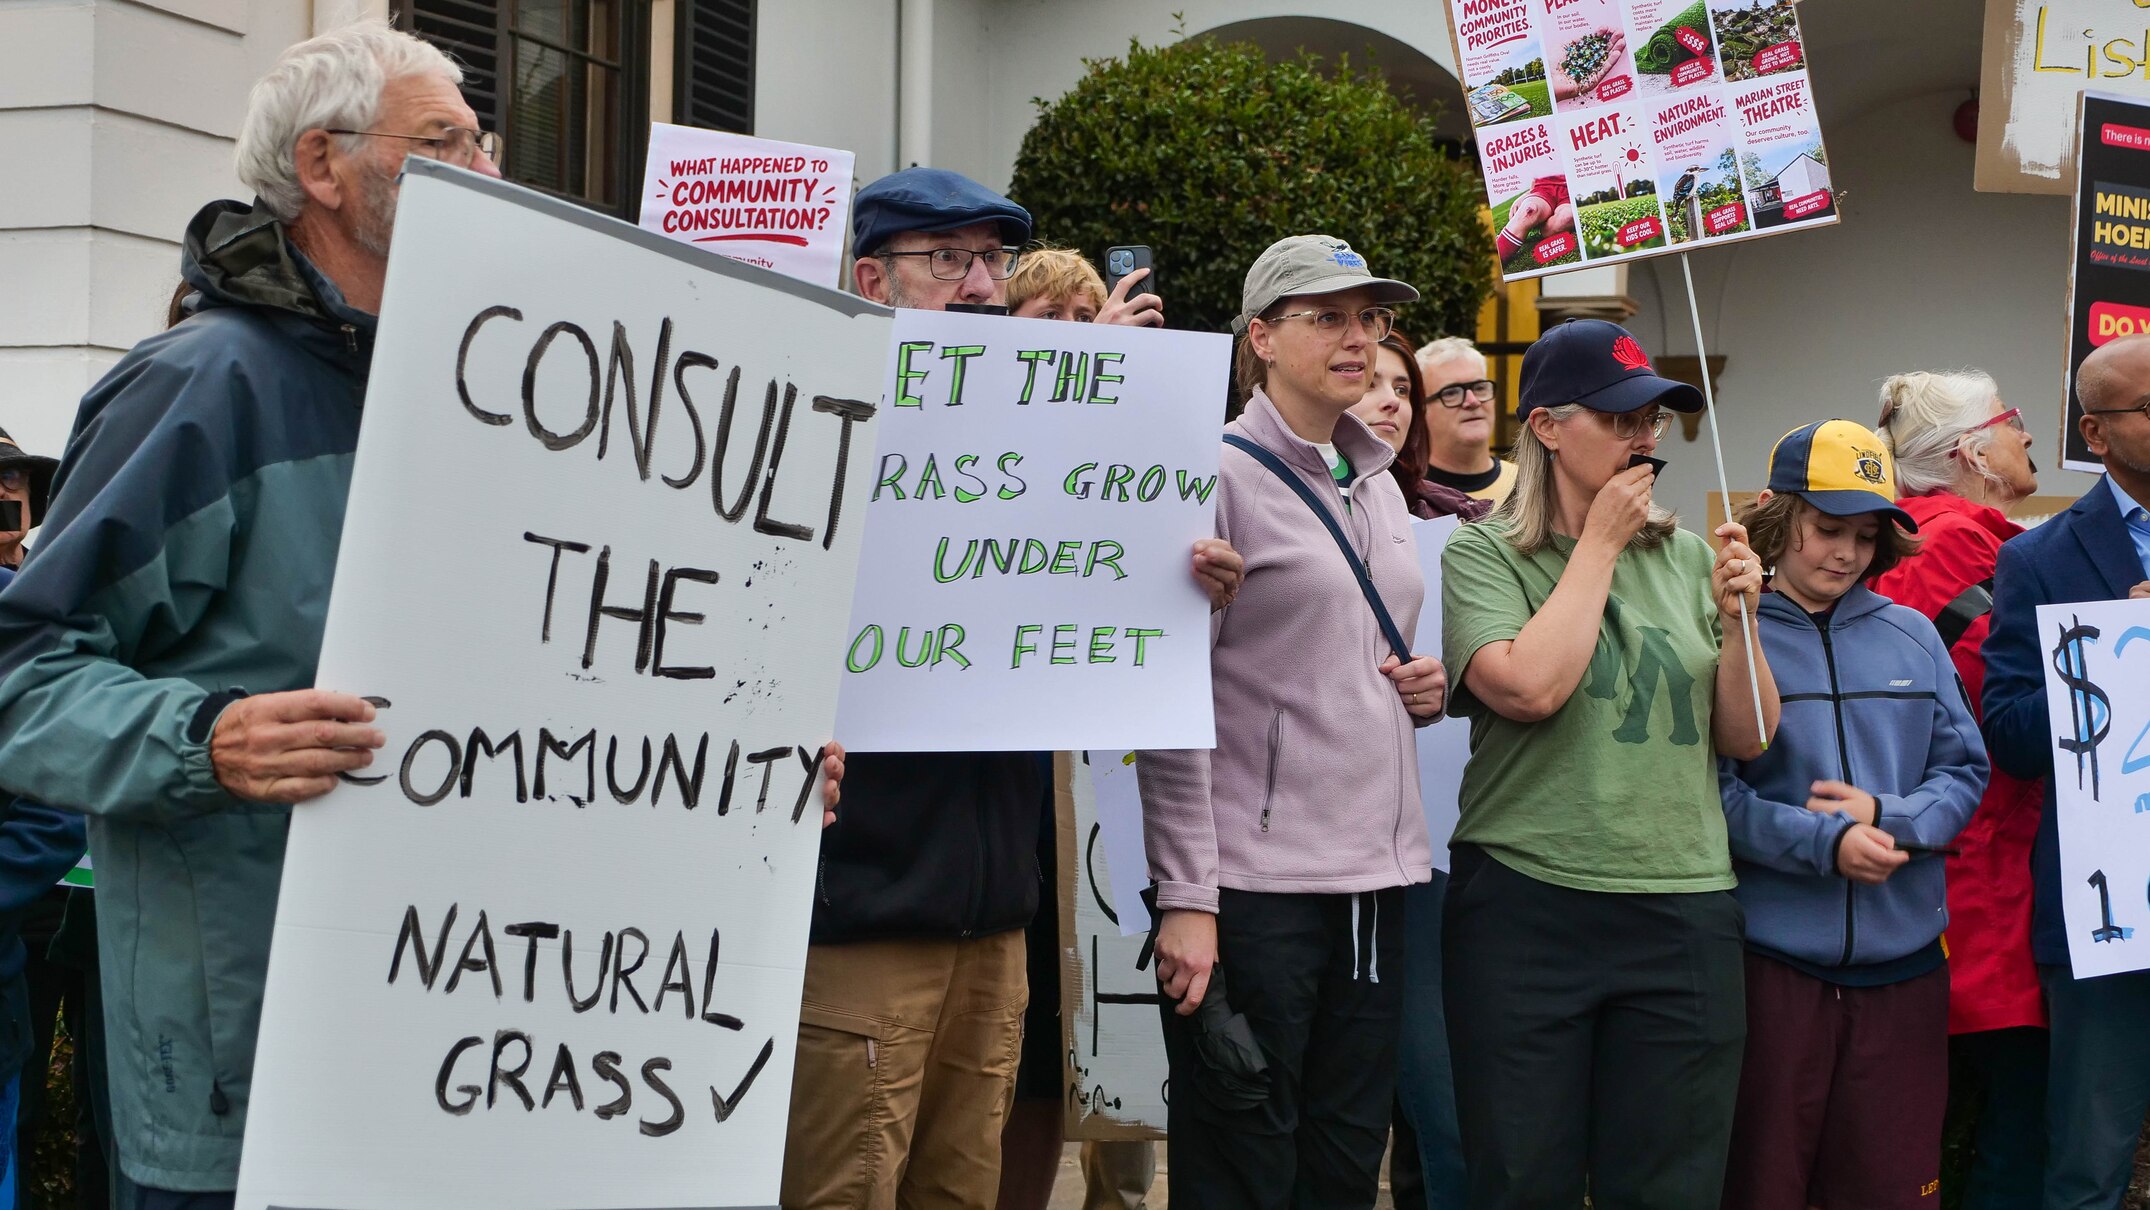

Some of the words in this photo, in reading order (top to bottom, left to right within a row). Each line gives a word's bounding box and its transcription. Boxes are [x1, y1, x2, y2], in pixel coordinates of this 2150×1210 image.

[1631, 2, 1653, 10] Synthetic
[1460, 4, 1527, 36] COMMUNITY
[1467, 18, 1533, 51] PRIORITIES.
[1683, 33, 1705, 51] $$$$
[1761, 50, 1774, 58] REAL
[1774, 45, 1790, 54] GRASS
[1780, 50, 1790, 58] NOT
[1679, 63, 1694, 72] INVEST
[1759, 63, 1772, 71] GOES
[1612, 79, 1625, 87] GRASS
[1735, 87, 1774, 109] MARIAN
[1775, 79, 1805, 95] STREET
[1658, 94, 1712, 126] NATURAL
[1743, 92, 1803, 126] THEATRE
[1569, 112, 1627, 151] HEAT.
[1653, 106, 1727, 144] ENVIRONMENT.
[1758, 124, 1791, 135] community
[1485, 127, 1536, 158] GRAZES
[1538, 123, 1548, 139] &
[1663, 143, 1684, 151] Synthetic
[1747, 136, 1773, 145] deserves
[1774, 132, 1797, 140] culture,
[2105, 129, 2132, 143] There
[2134, 133, 2142, 145] is
[671, 157, 717, 177] WHAT
[720, 156, 806, 175] HAPPENED
[811, 160, 829, 173] TO
[1492, 139, 1555, 174] INJURIES.
[672, 178, 818, 207] COMMUNITY
[1711, 211, 1722, 219] REAL
[1722, 206, 1736, 215] GRASS
[1795, 206, 1807, 214] NEED
[2096, 191, 2150, 220] MINI
[662, 207, 831, 233] CONSULTATION?
[1626, 224, 1639, 234] KEEP
[1640, 221, 1650, 229] OUR
[1713, 212, 1736, 224] SUPPORTS
[1714, 221, 1726, 230] REAL
[1538, 243, 1550, 252] REAL
[1550, 237, 1565, 247] GRASS
[1625, 232, 1639, 242] KIDS
[1639, 227, 1655, 238] COOL.
[1542, 251, 1549, 259] IS
[1549, 244, 1568, 256] SAFER.
[2110, 253, 2118, 264] of
[2118, 253, 2128, 263] the
[2128, 255, 2149, 266] Local
[2099, 313, 2134, 337] DO
[884, 340, 987, 410] ET
[1016, 349, 1126, 406] THE
[456, 304, 878, 551] CONSULT
[871, 451, 1027, 504] RASS
[1063, 462, 1218, 506] GROW
[933, 536, 1129, 584] UNDER
[523, 530, 721, 680] THE
[846, 622, 973, 673] OUR
[1009, 623, 1171, 670] FEET
[387, 902, 745, 1031] NATURAL
[435, 1028, 685, 1138] GRASS
